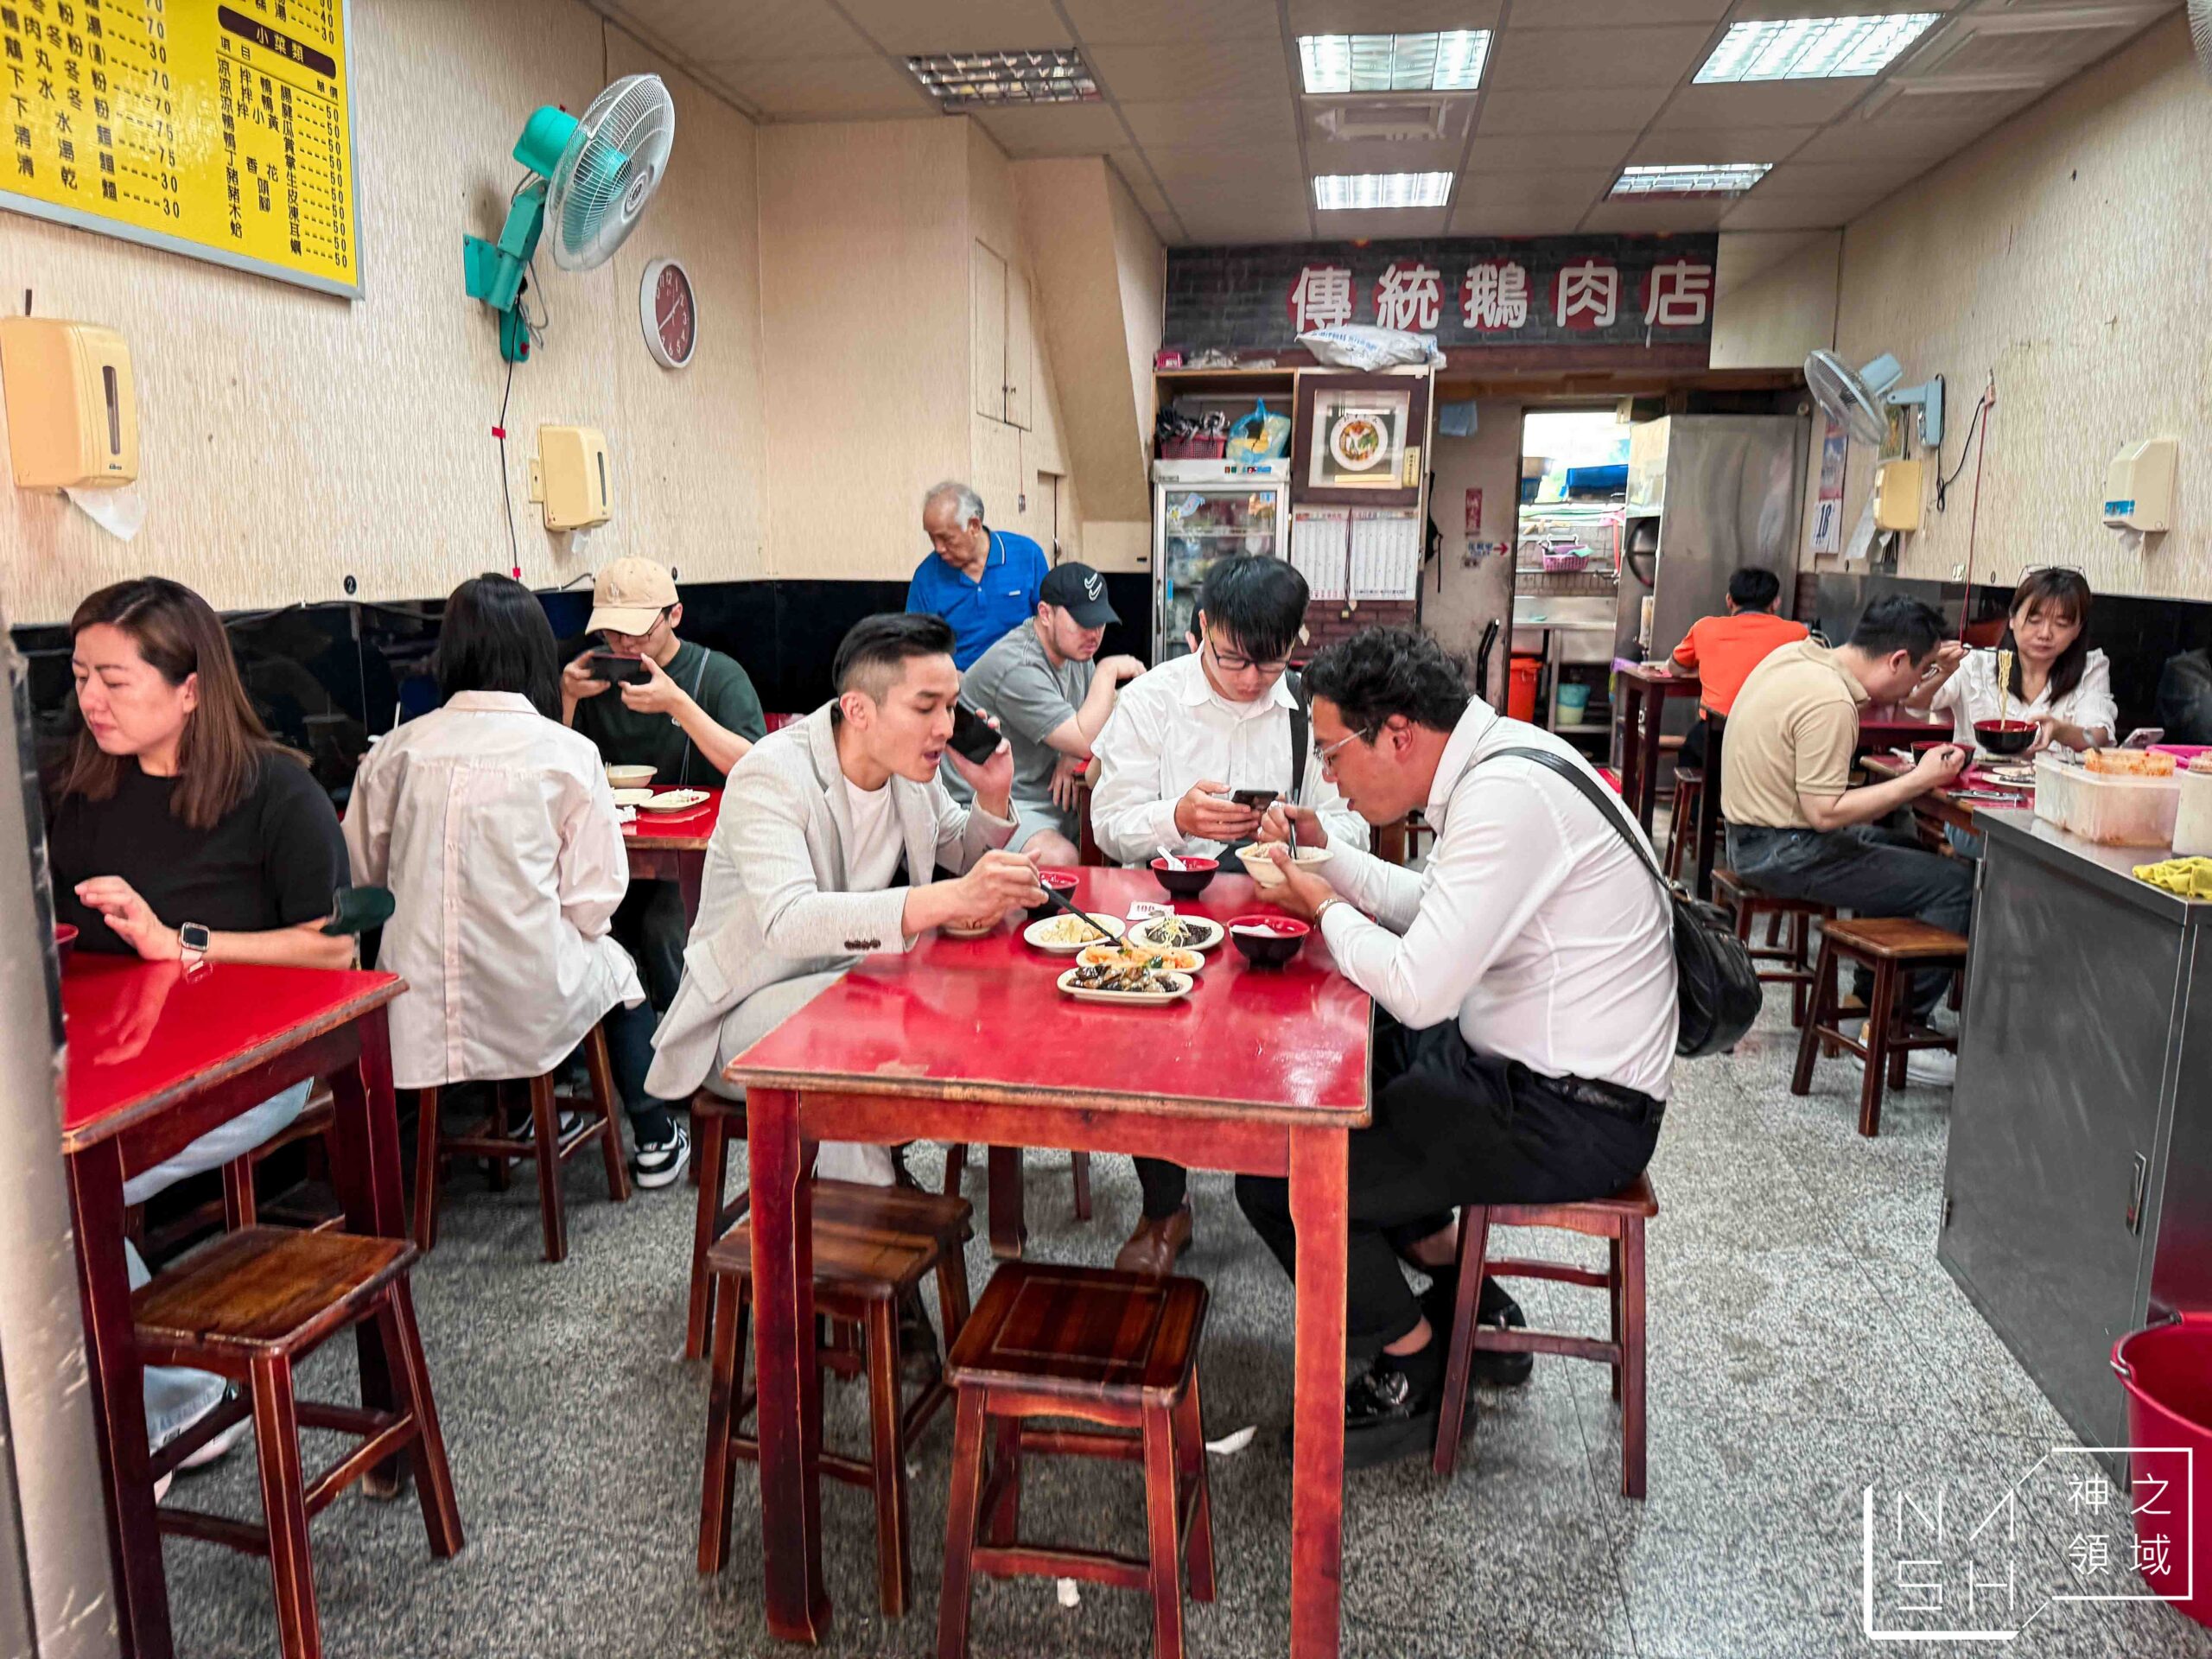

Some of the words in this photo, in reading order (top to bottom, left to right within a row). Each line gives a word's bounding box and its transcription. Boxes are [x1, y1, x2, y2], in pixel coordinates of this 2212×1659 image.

[146, 16, 164, 40] 70
[321, 10, 334, 28] 40
[256, 26, 304, 63] 小菜類
[322, 26, 334, 44] 30
[149, 40, 167, 64] 30
[220, 36, 251, 60] 項目
[152, 68, 169, 91] 70
[156, 98, 171, 115] 70
[327, 104, 339, 123] 50
[157, 120, 174, 142] 75
[220, 94, 294, 138] 涼拌小黃瓜
[328, 137, 340, 155] 50
[327, 121, 340, 138] 50
[160, 145, 175, 167] 75
[329, 155, 341, 171] 50
[161, 173, 178, 194] 30
[225, 148, 297, 188] 丁香花生
[331, 188, 343, 204] 50
[330, 171, 342, 188] 50
[163, 198, 180, 219] 30
[333, 203, 344, 219] 50
[229, 203, 300, 238] 木耳
[334, 237, 346, 252] 50
[334, 220, 345, 236] 50
[335, 252, 347, 268] 50
[1292, 260, 1711, 330] 傳統鵝肉店
